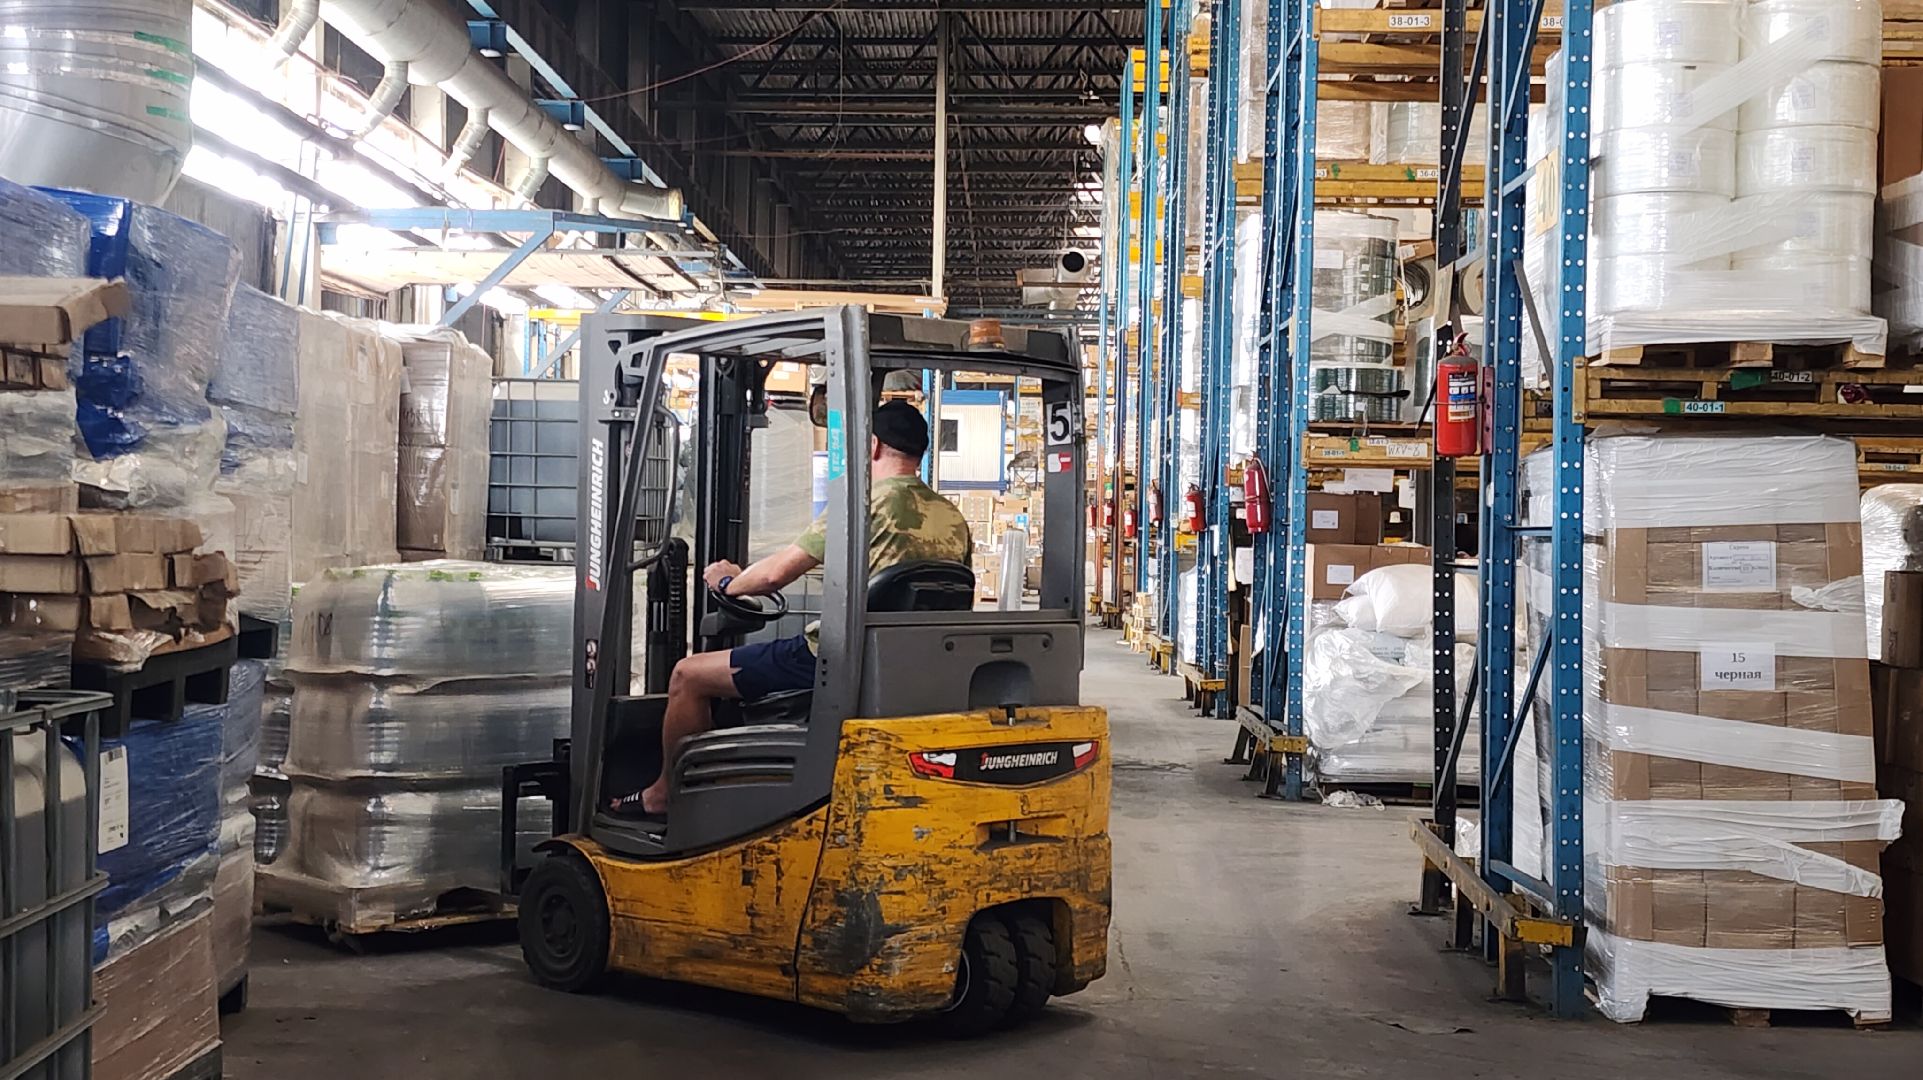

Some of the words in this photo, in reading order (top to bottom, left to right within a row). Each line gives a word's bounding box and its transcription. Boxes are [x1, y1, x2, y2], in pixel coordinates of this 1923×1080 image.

[1390, 16, 1430, 26] 38-01-3
[1686, 403, 1725, 412] 40-01-1
[1050, 403, 1070, 442] 5
[585, 438, 604, 591] JUNGHEINRICH
[1732, 652, 1746, 663] 15
[1715, 671, 1762, 682] черная
[980, 751, 1058, 770] JUNGHEINRICH
